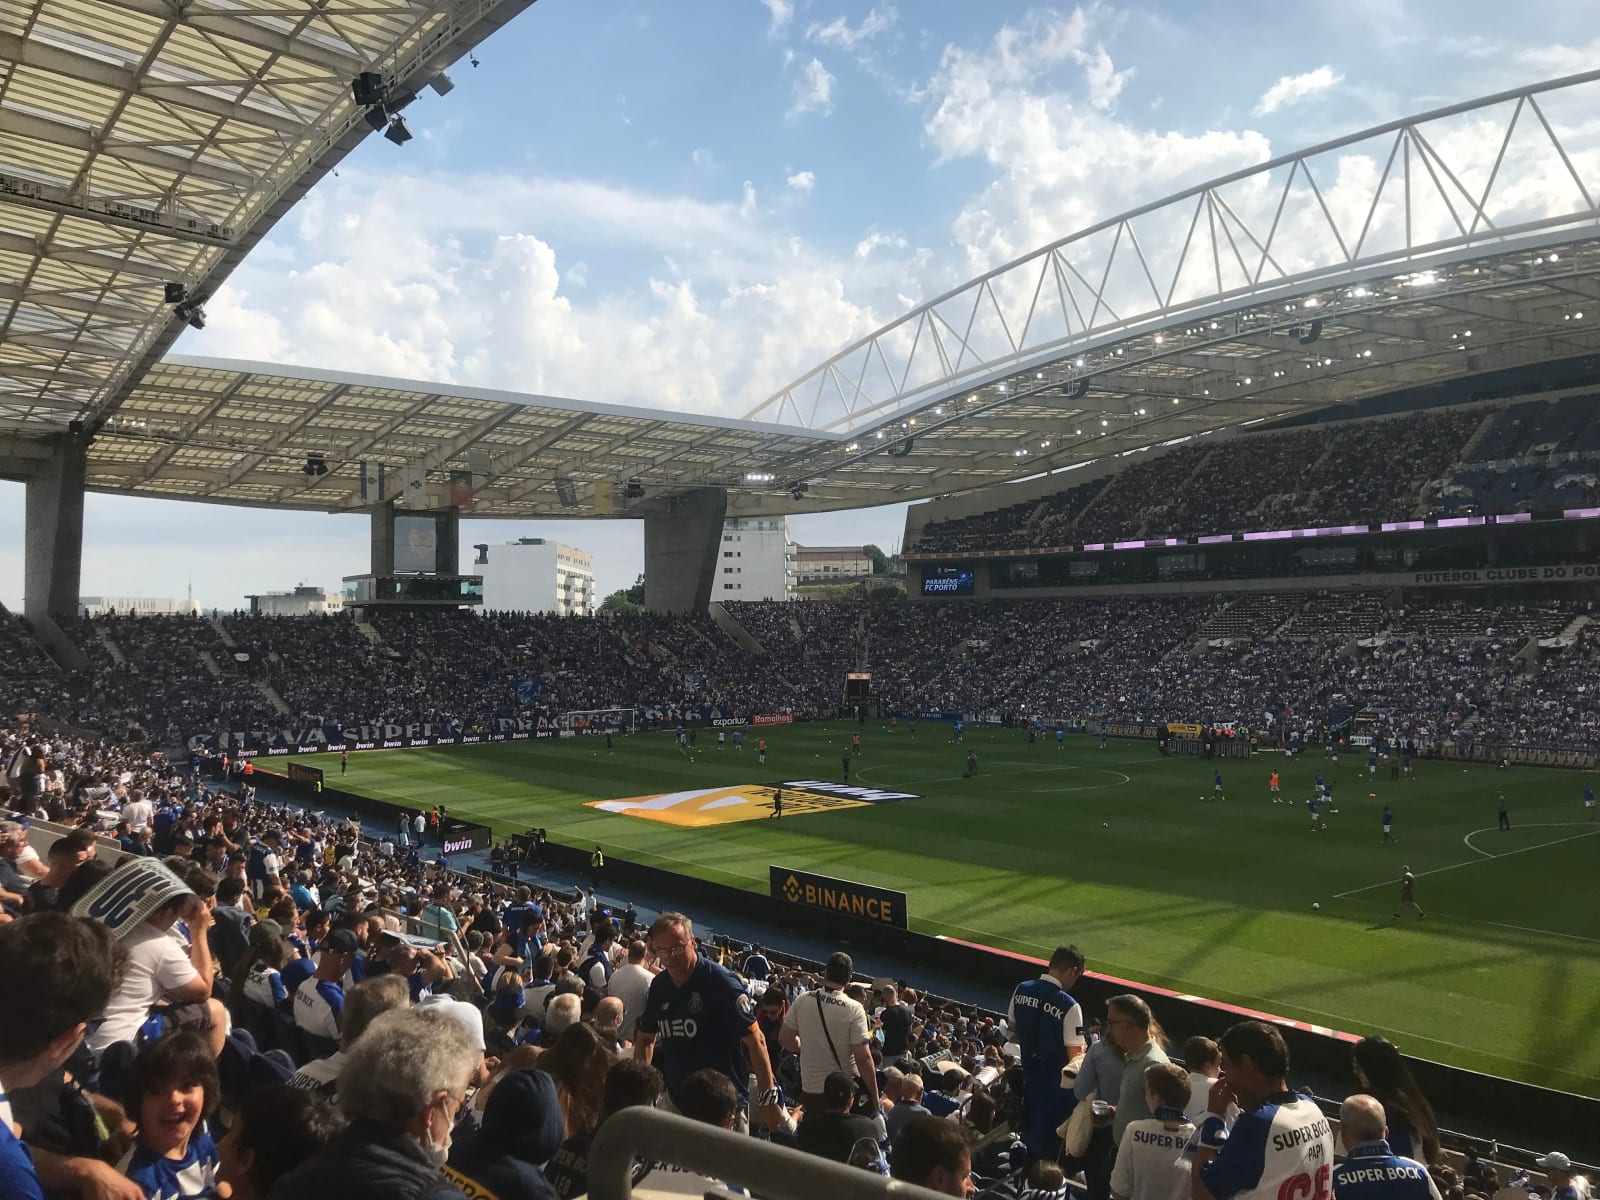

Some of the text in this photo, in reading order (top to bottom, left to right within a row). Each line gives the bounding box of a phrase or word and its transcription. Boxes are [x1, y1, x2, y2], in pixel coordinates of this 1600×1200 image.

[1415, 565, 1600, 583] FUTEBOL CLUBE DO PO
[755, 714, 790, 724] Ramalhos
[384, 740, 402, 748] bwin
[411, 738, 429, 746] bwin
[437, 737, 455, 745] bwin
[463, 735, 480, 743] bwin
[298, 745, 318, 753] bwin
[327, 743, 347, 751] bwin
[355, 741, 374, 749] bwin
[238, 749, 258, 757] bwin
[268, 747, 288, 755] bwin
[444, 837, 472, 853] bwin
[805, 884, 892, 922] BINANCE
[247, 972, 265, 986] OCK
[826, 996, 847, 1008] BOCK
[1015, 994, 1065, 1020] SUPER OCK
[1134, 1130, 1173, 1148] SUPER
[1273, 1126, 1312, 1151] SUPER
[1338, 1168, 1385, 1185] SUPER
[1386, 1166, 1422, 1181] BOCK
